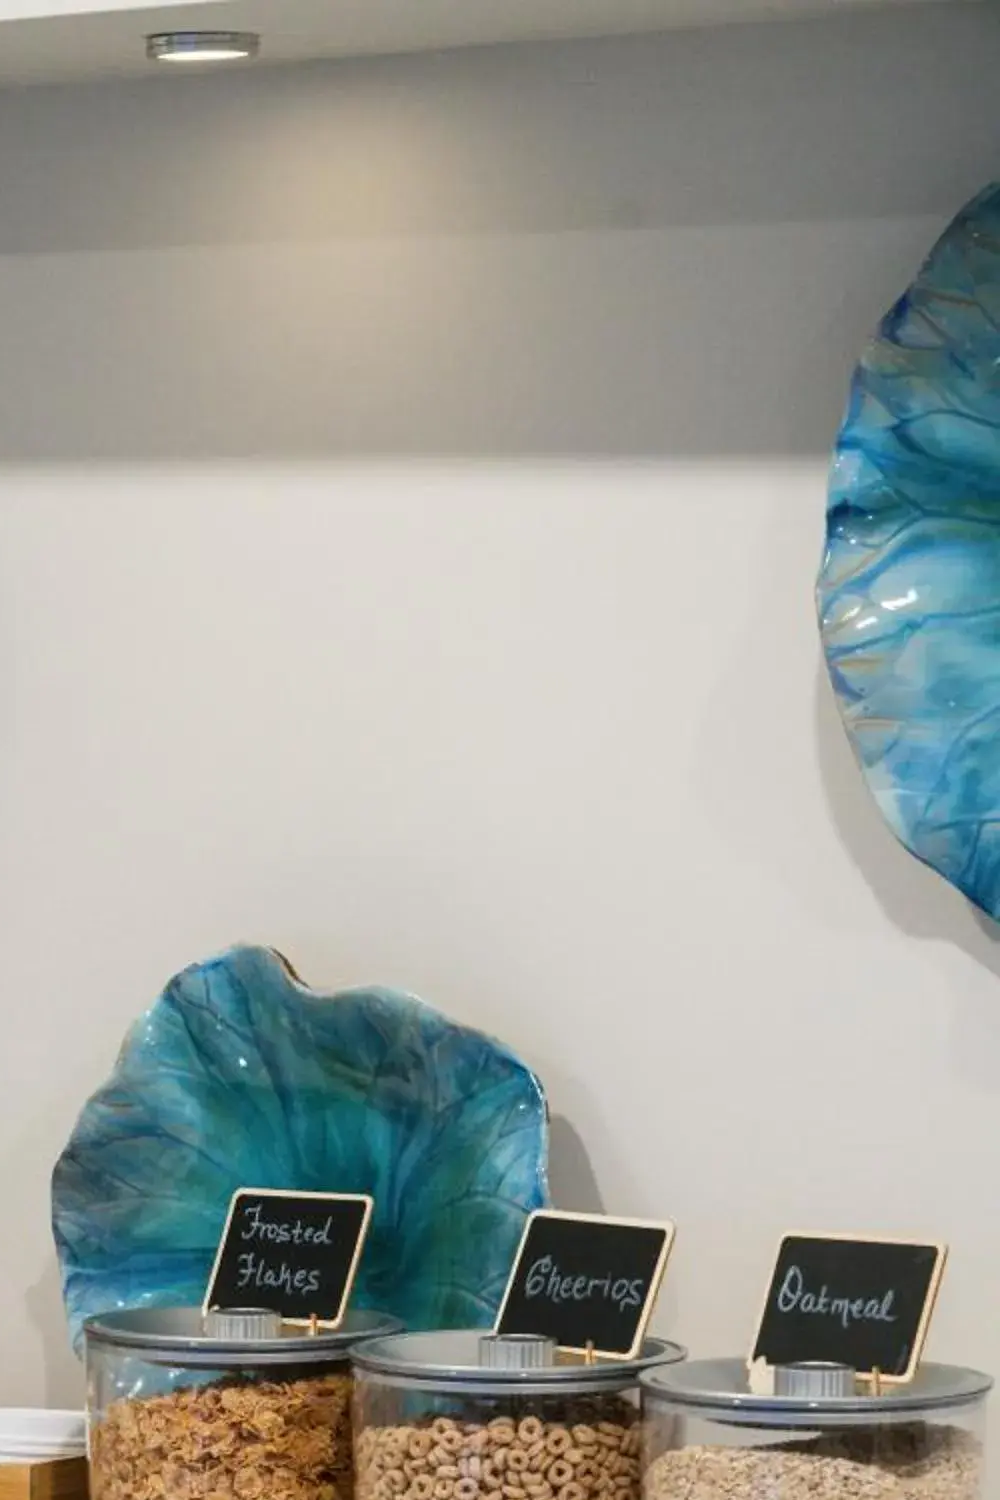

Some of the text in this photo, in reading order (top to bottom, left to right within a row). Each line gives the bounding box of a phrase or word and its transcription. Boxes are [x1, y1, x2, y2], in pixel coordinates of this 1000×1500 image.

[241, 1203, 333, 1245] Frosted
[237, 1251, 321, 1296] Flakes
[525, 1254, 644, 1313] Cheerios
[777, 1264, 899, 1329] Oatmeal
